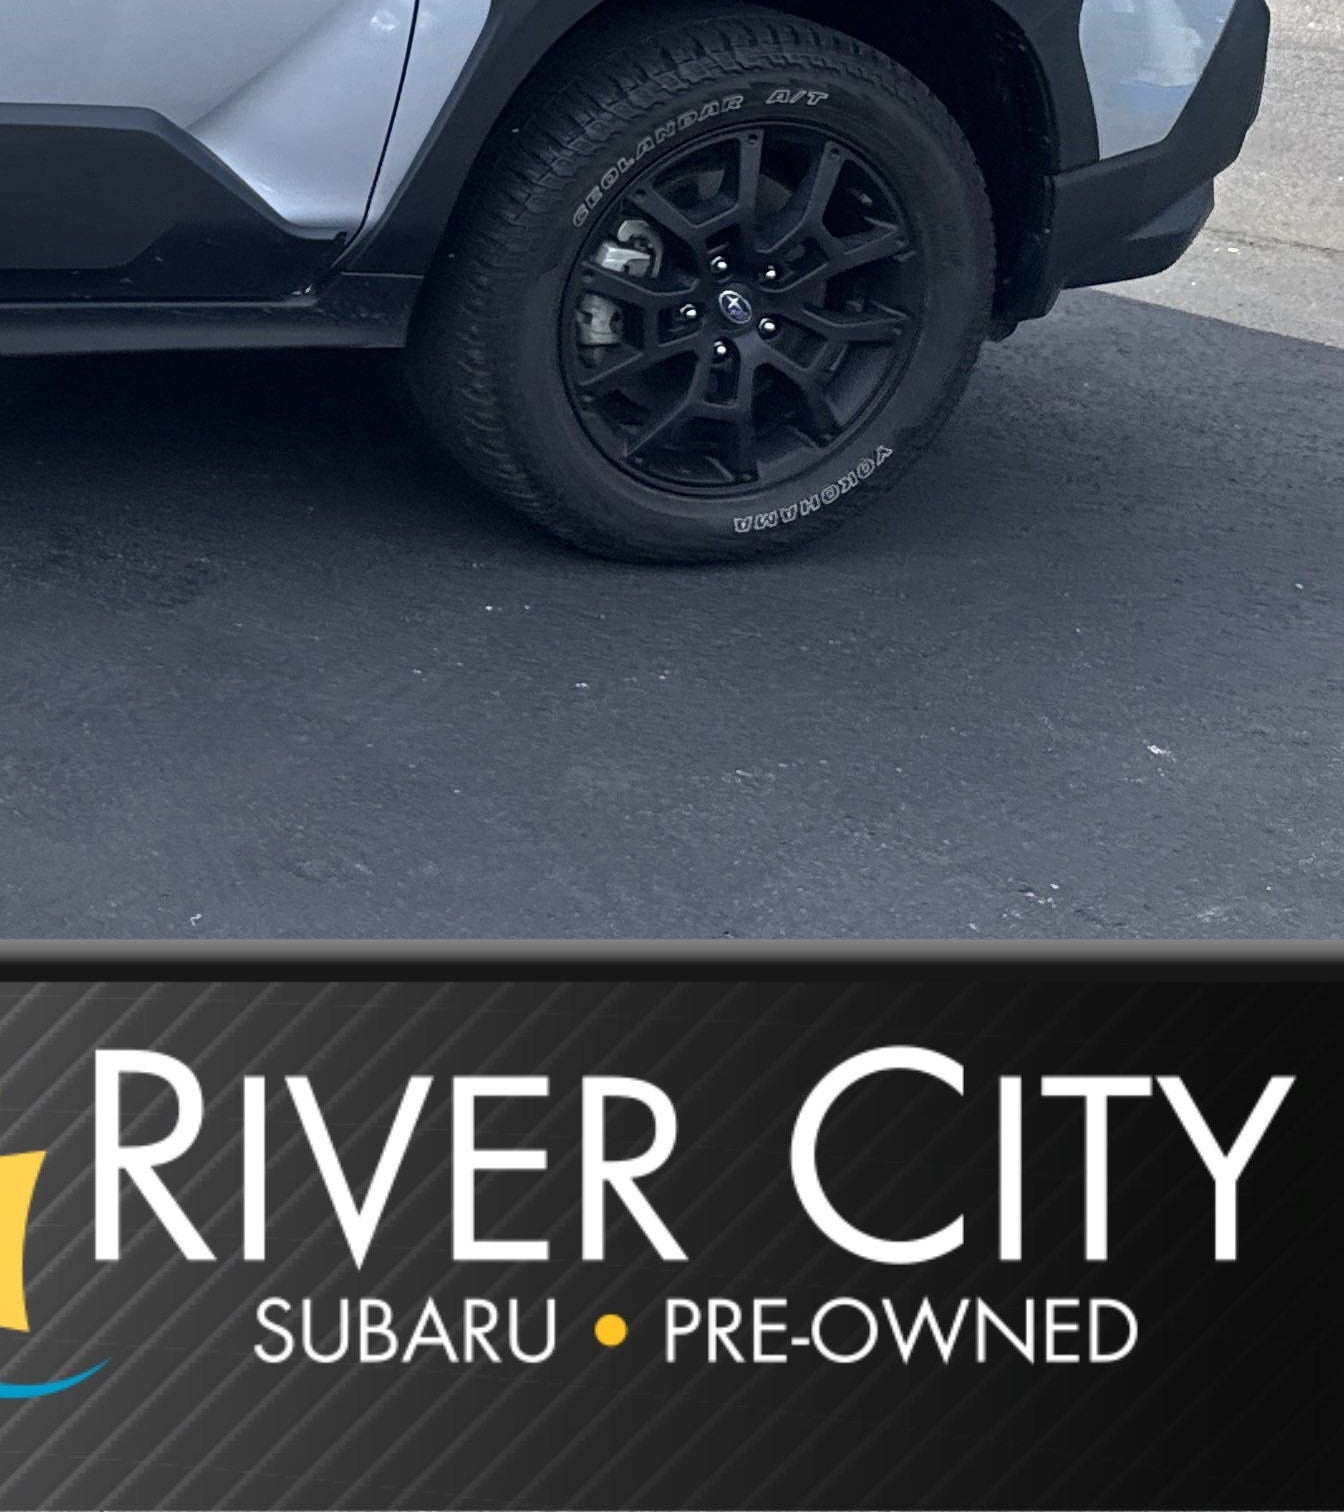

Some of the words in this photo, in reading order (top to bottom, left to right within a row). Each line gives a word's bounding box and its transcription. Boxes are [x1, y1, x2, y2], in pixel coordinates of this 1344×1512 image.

[572, 94, 745, 227] GEOLANDAR
[765, 89, 830, 107] A/T
[733, 445, 894, 533] YOKOHAMA
